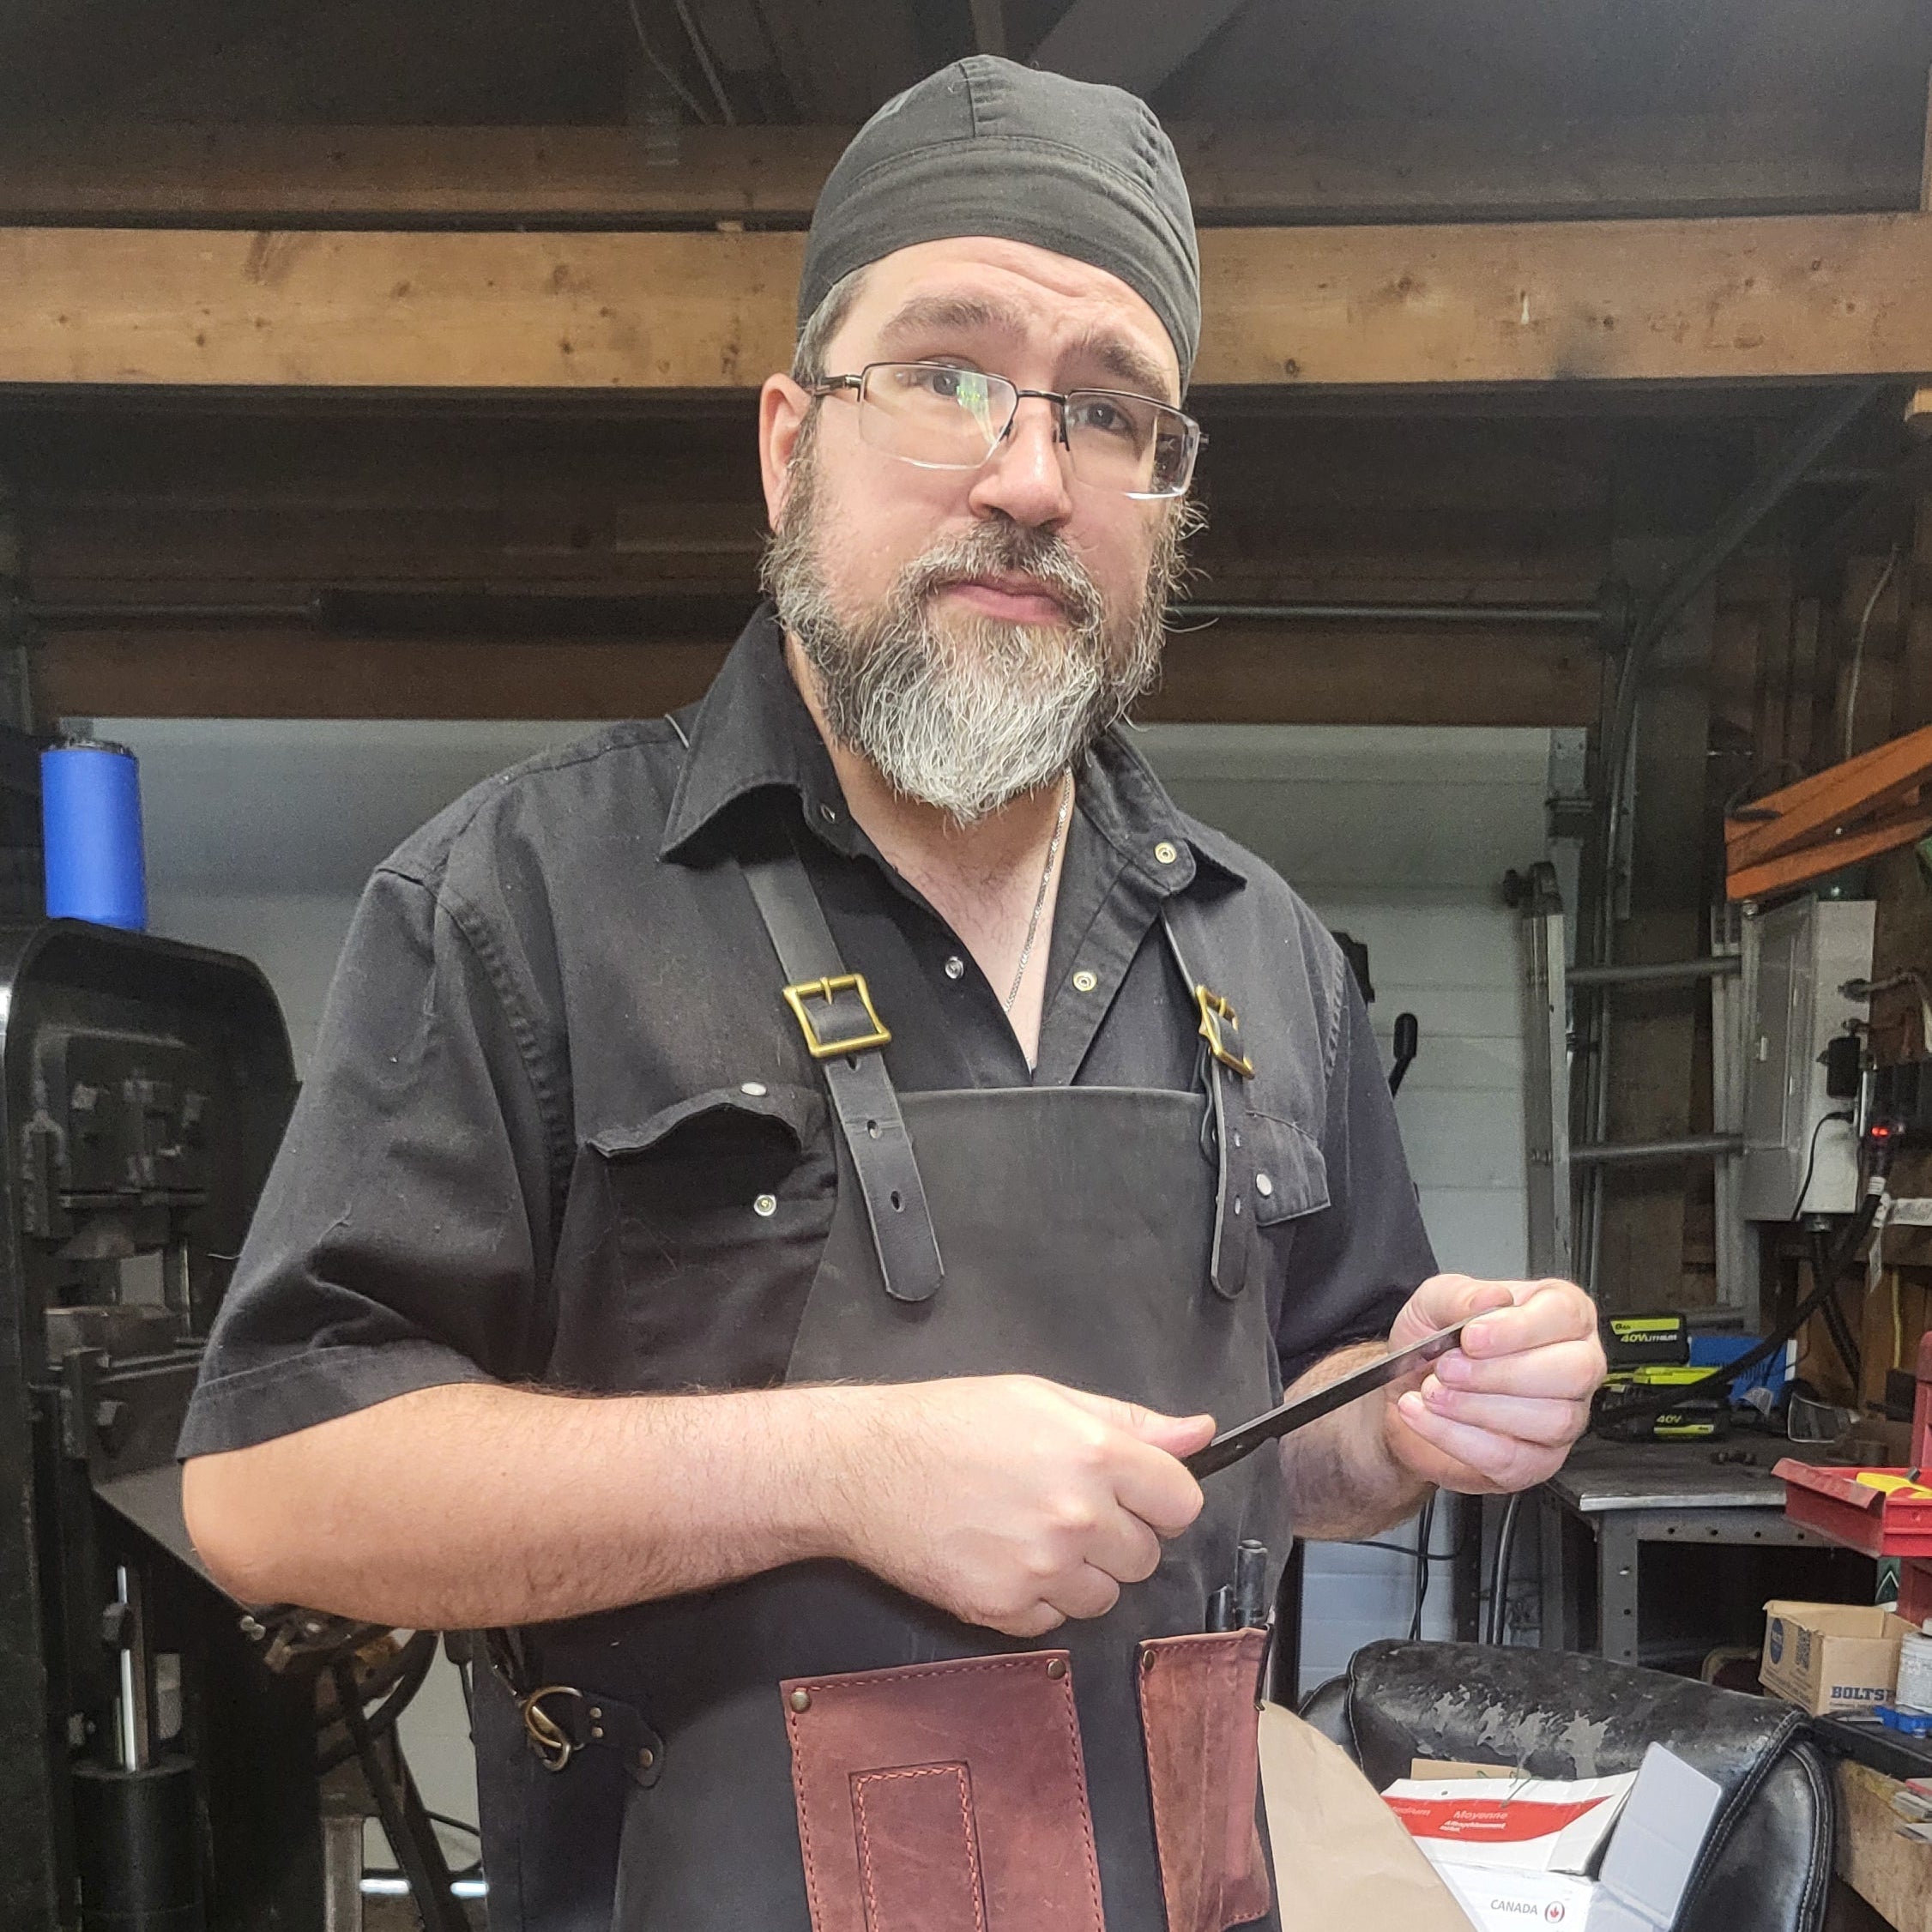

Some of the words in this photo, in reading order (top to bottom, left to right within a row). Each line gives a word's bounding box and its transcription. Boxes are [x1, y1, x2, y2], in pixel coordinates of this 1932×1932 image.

[1657, 1415, 1681, 1423] 40V
[1831, 1686, 1886, 1701] BOLTS
[1453, 1810, 1508, 1820] Moyenne
[1490, 1899, 1538, 1916] CANADA
